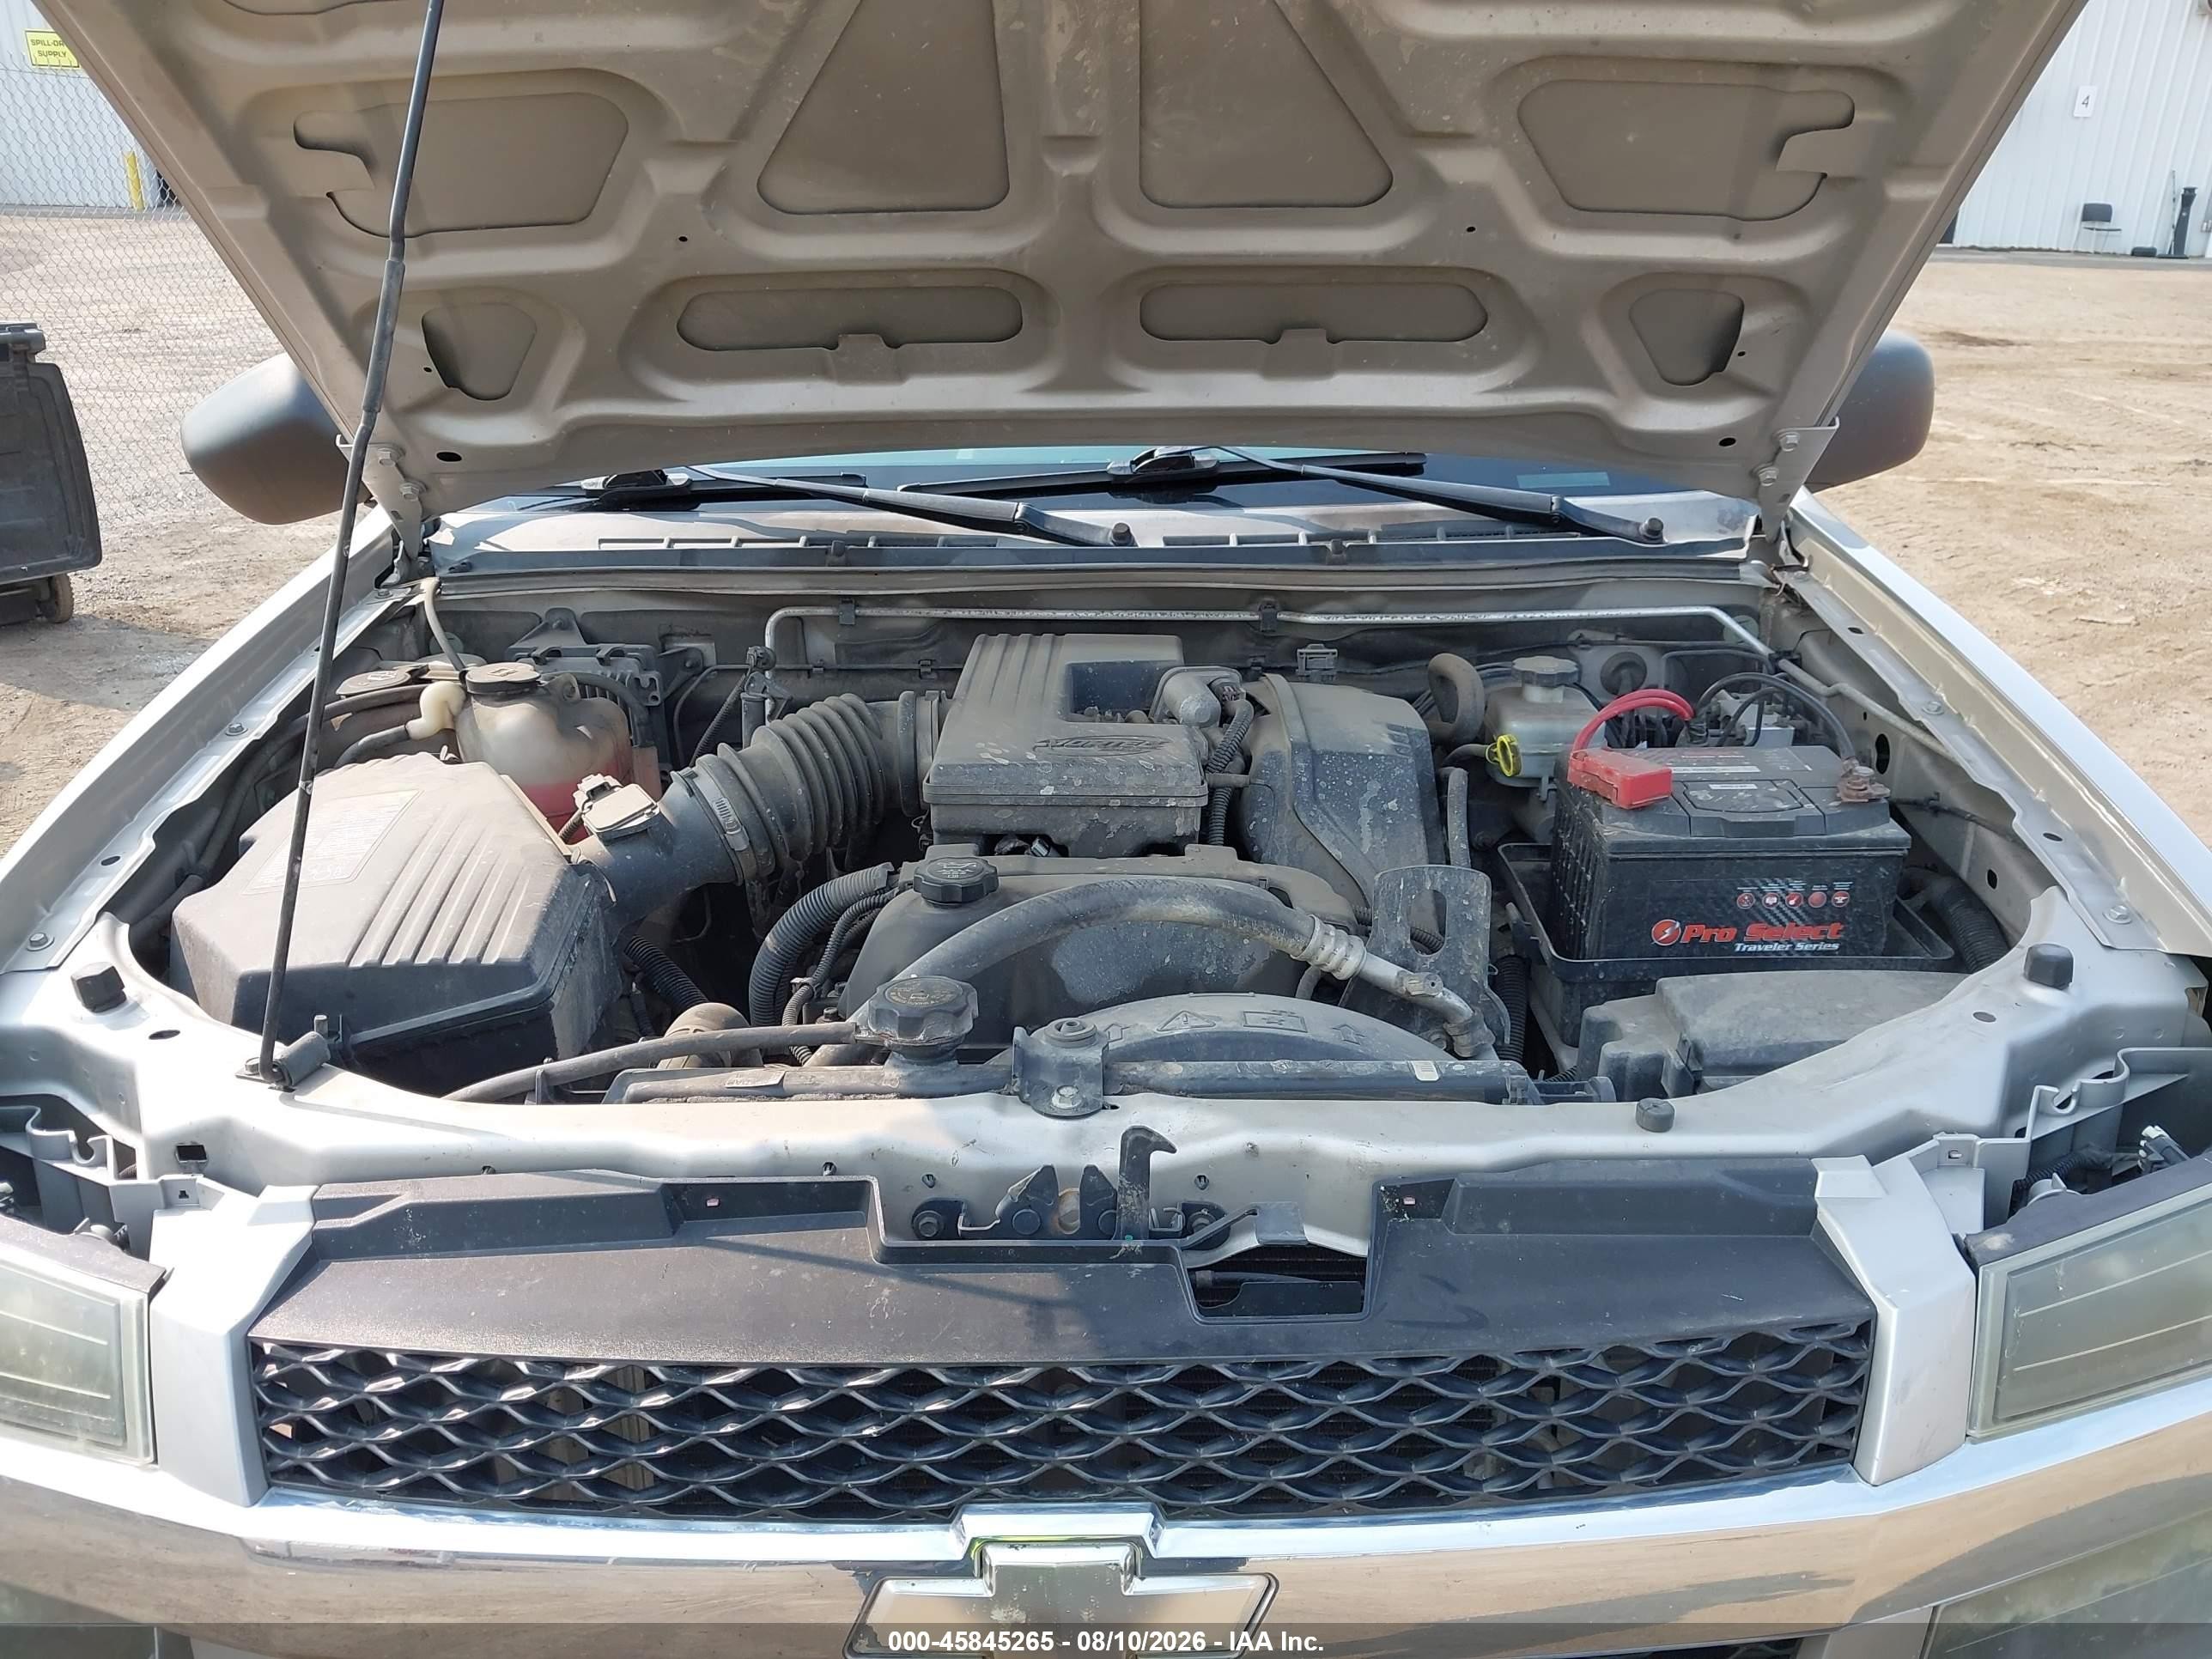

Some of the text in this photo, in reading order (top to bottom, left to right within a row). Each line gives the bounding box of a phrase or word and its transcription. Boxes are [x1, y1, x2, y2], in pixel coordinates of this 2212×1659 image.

[2081, 94, 2090, 108] 4
[1680, 921, 1844, 944] Pro Select
[1734, 941, 1840, 952] Traveler Series
